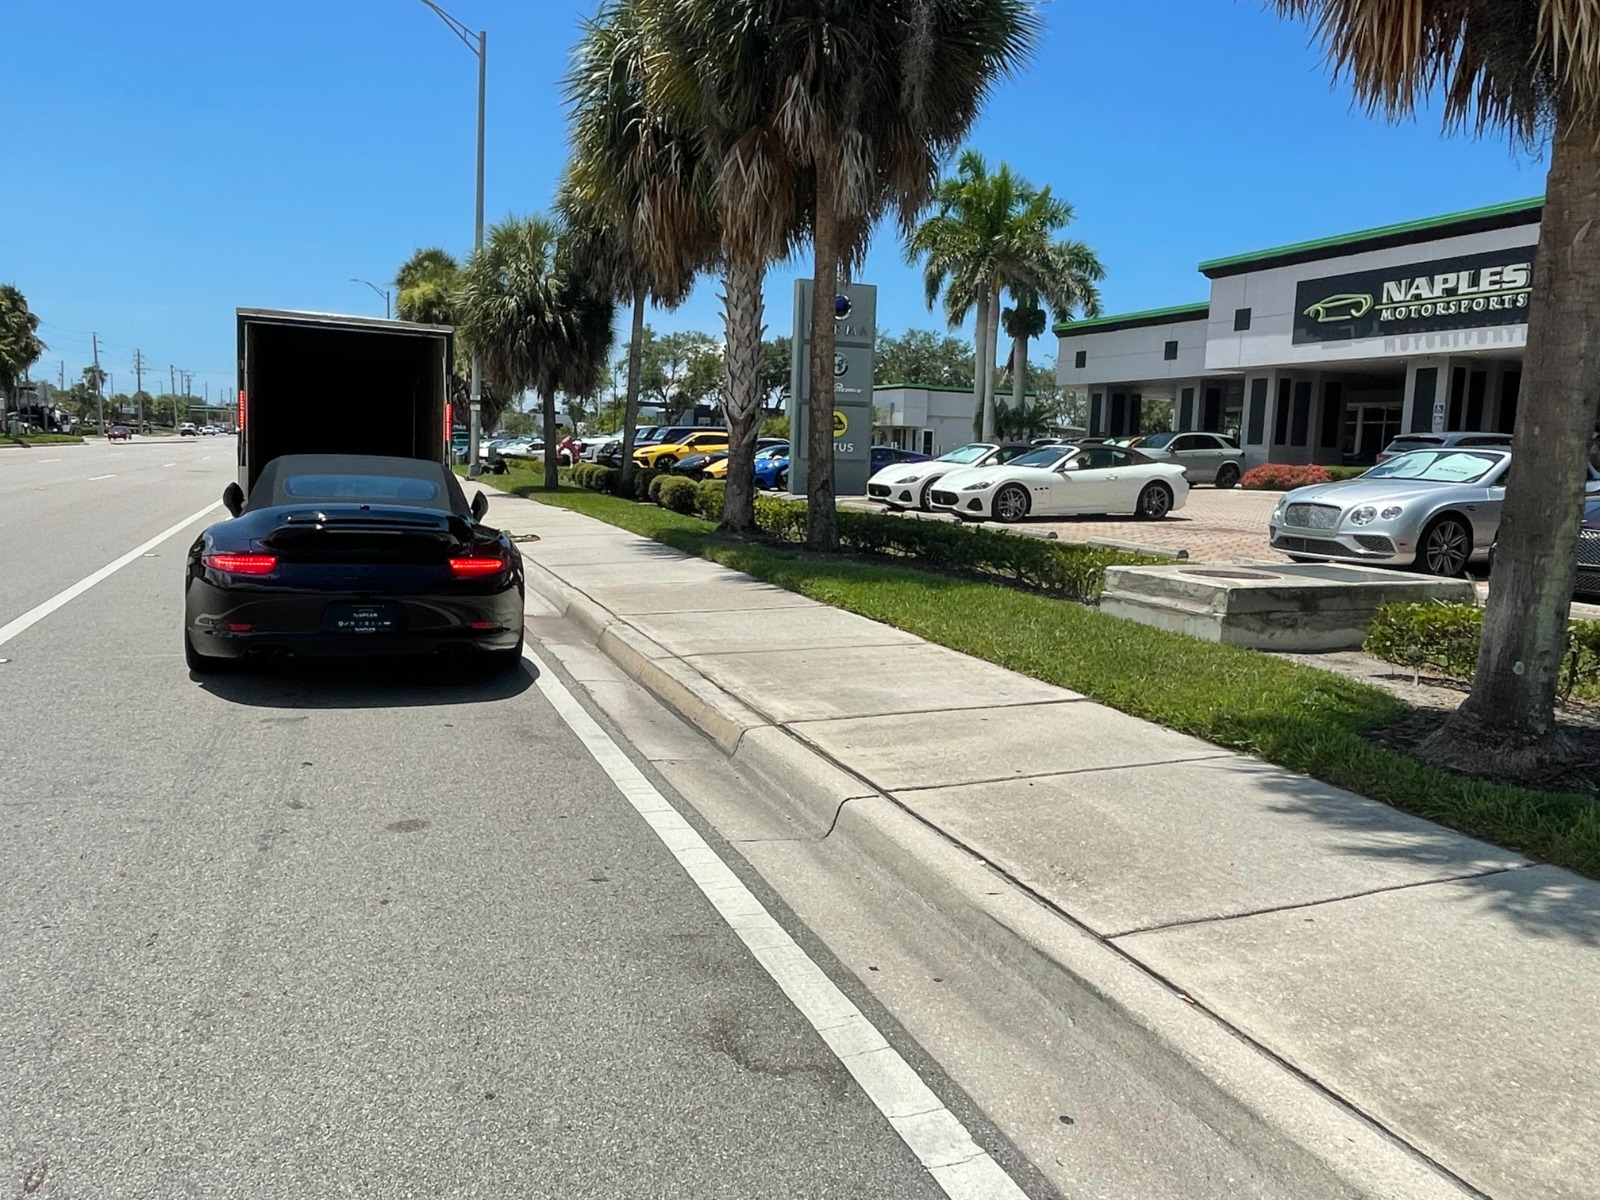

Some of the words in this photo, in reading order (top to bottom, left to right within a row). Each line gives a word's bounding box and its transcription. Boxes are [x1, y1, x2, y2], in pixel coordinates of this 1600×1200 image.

[1382, 262, 1531, 303] NAPLES
[1380, 293, 1528, 321] MOTORSPORTS
[809, 322, 868, 337] RMA
[833, 442, 854, 453] TUS
